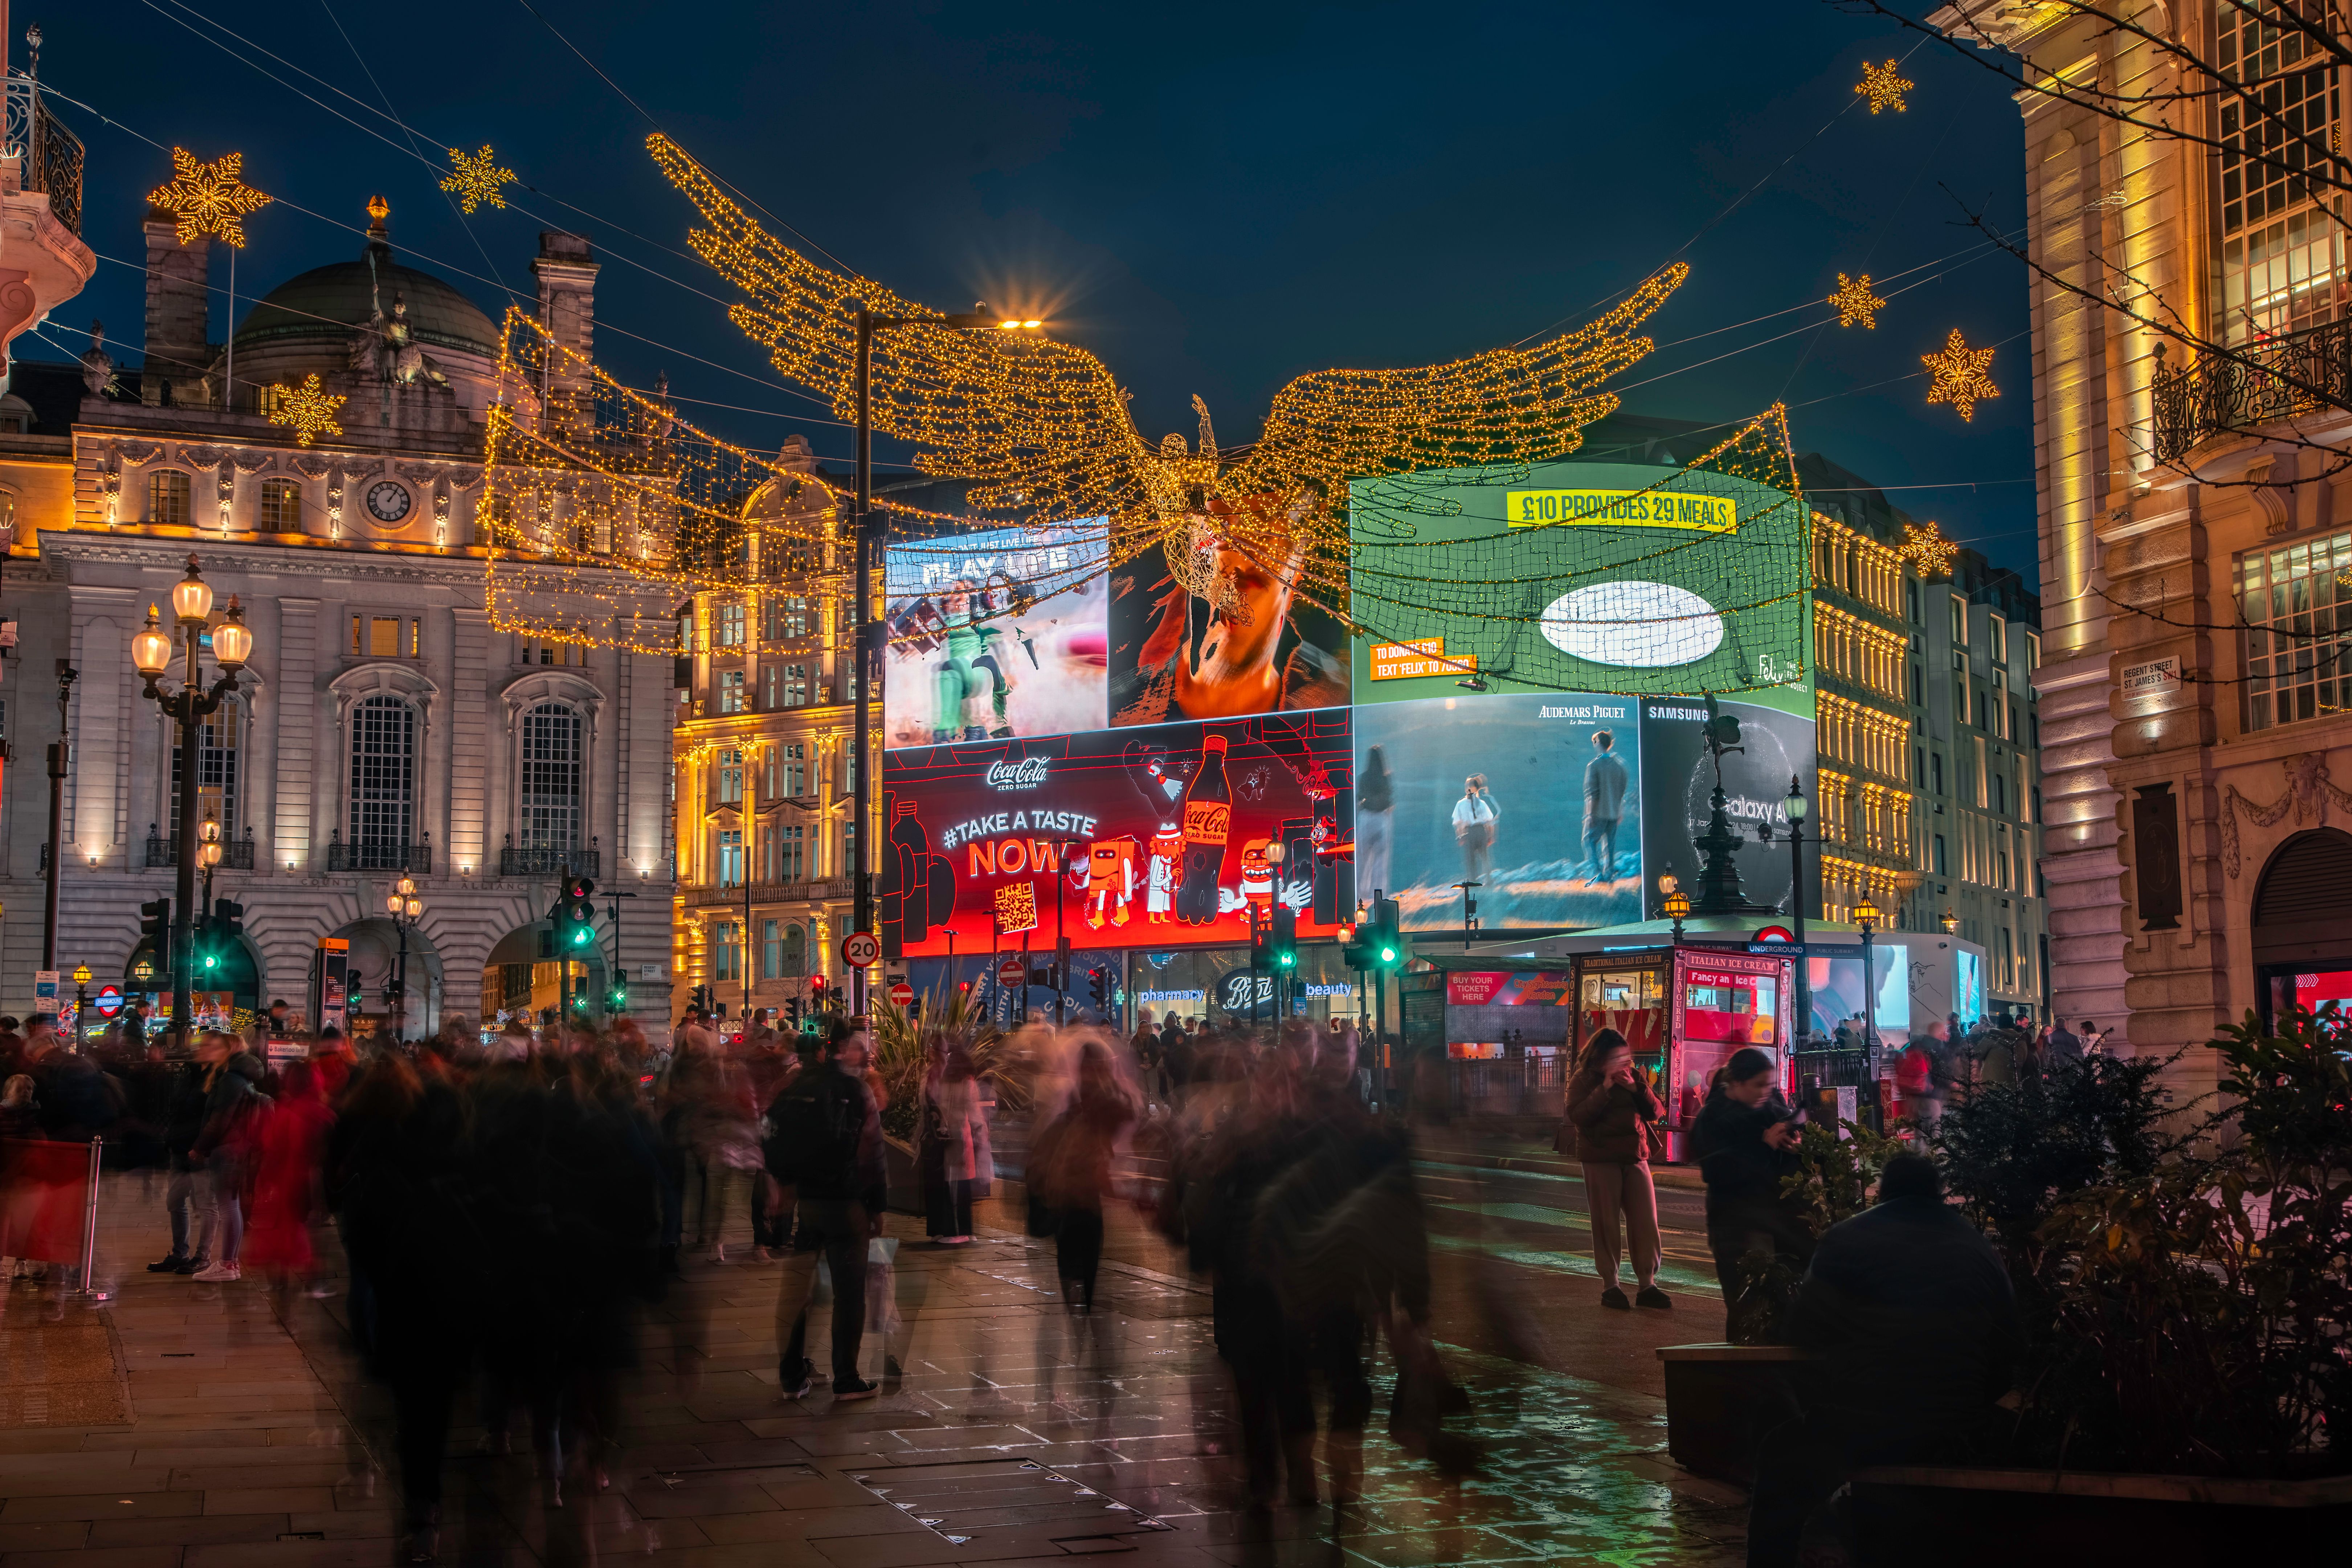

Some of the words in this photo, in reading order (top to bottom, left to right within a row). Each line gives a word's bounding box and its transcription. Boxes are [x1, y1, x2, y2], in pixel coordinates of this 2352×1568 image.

[1522, 496, 1557, 520] £10
[1562, 495, 1648, 520] PROVIDES
[1653, 498, 1674, 520] 29
[1679, 499, 1727, 526] MEALS
[981, 540, 1000, 550] JUST
[1001, 538, 1020, 547] LIVE
[923, 556, 998, 585] PLAY
[1376, 647, 1387, 660] TO
[1388, 643, 1420, 658] DONATE
[1421, 641, 1437, 654] £10
[1377, 663, 1397, 677] TEXT
[1428, 660, 1439, 673] TO
[1787, 662, 1796, 671] THE
[2124, 666, 2148, 678] REGENT
[2150, 660, 2173, 673] STREET
[2124, 679, 2133, 689] ST.
[2135, 673, 2161, 687] JAMES'S
[2163, 670, 2177, 681] SW1
[1538, 705, 1591, 718] AUDEMARS
[1593, 705, 1625, 719] PIGUET
[1649, 706, 1708, 721] SAMSUNG
[987, 756, 1051, 785] Coca-Cola
[944, 812, 1009, 849] #TAKE
[1012, 810, 1028, 830] A
[1032, 810, 1098, 838] TASTE
[1741, 823, 1753, 831] 18:00
[968, 837, 1068, 877] NOW
[301, 878, 361, 887] COUNTY
[461, 882, 532, 891] ALLIANCE
[850, 942, 875, 957] 20
[1749, 945, 1803, 954] UNDERGROUND
[1077, 952, 1098, 964] YOU
[1584, 957, 1614, 967] TRADITIONAL
[1615, 957, 1634, 966] ITALIAN
[1644, 955, 1662, 964] CREAM
[1691, 956, 1726, 967] ITALIAN
[1728, 959, 1742, 968] ICE
[1744, 961, 1775, 971] CREAM
[1514, 979, 1527, 989] City
[1528, 980, 1568, 989] Sightseeing
[1692, 972, 1718, 986] Fancy
[1735, 975, 1748, 985] Ice
[1140, 988, 1204, 1004] pharmacy
[1306, 982, 1352, 997] beauty
[1527, 990, 1556, 1000] London
[997, 990, 1010, 1022] WITH
